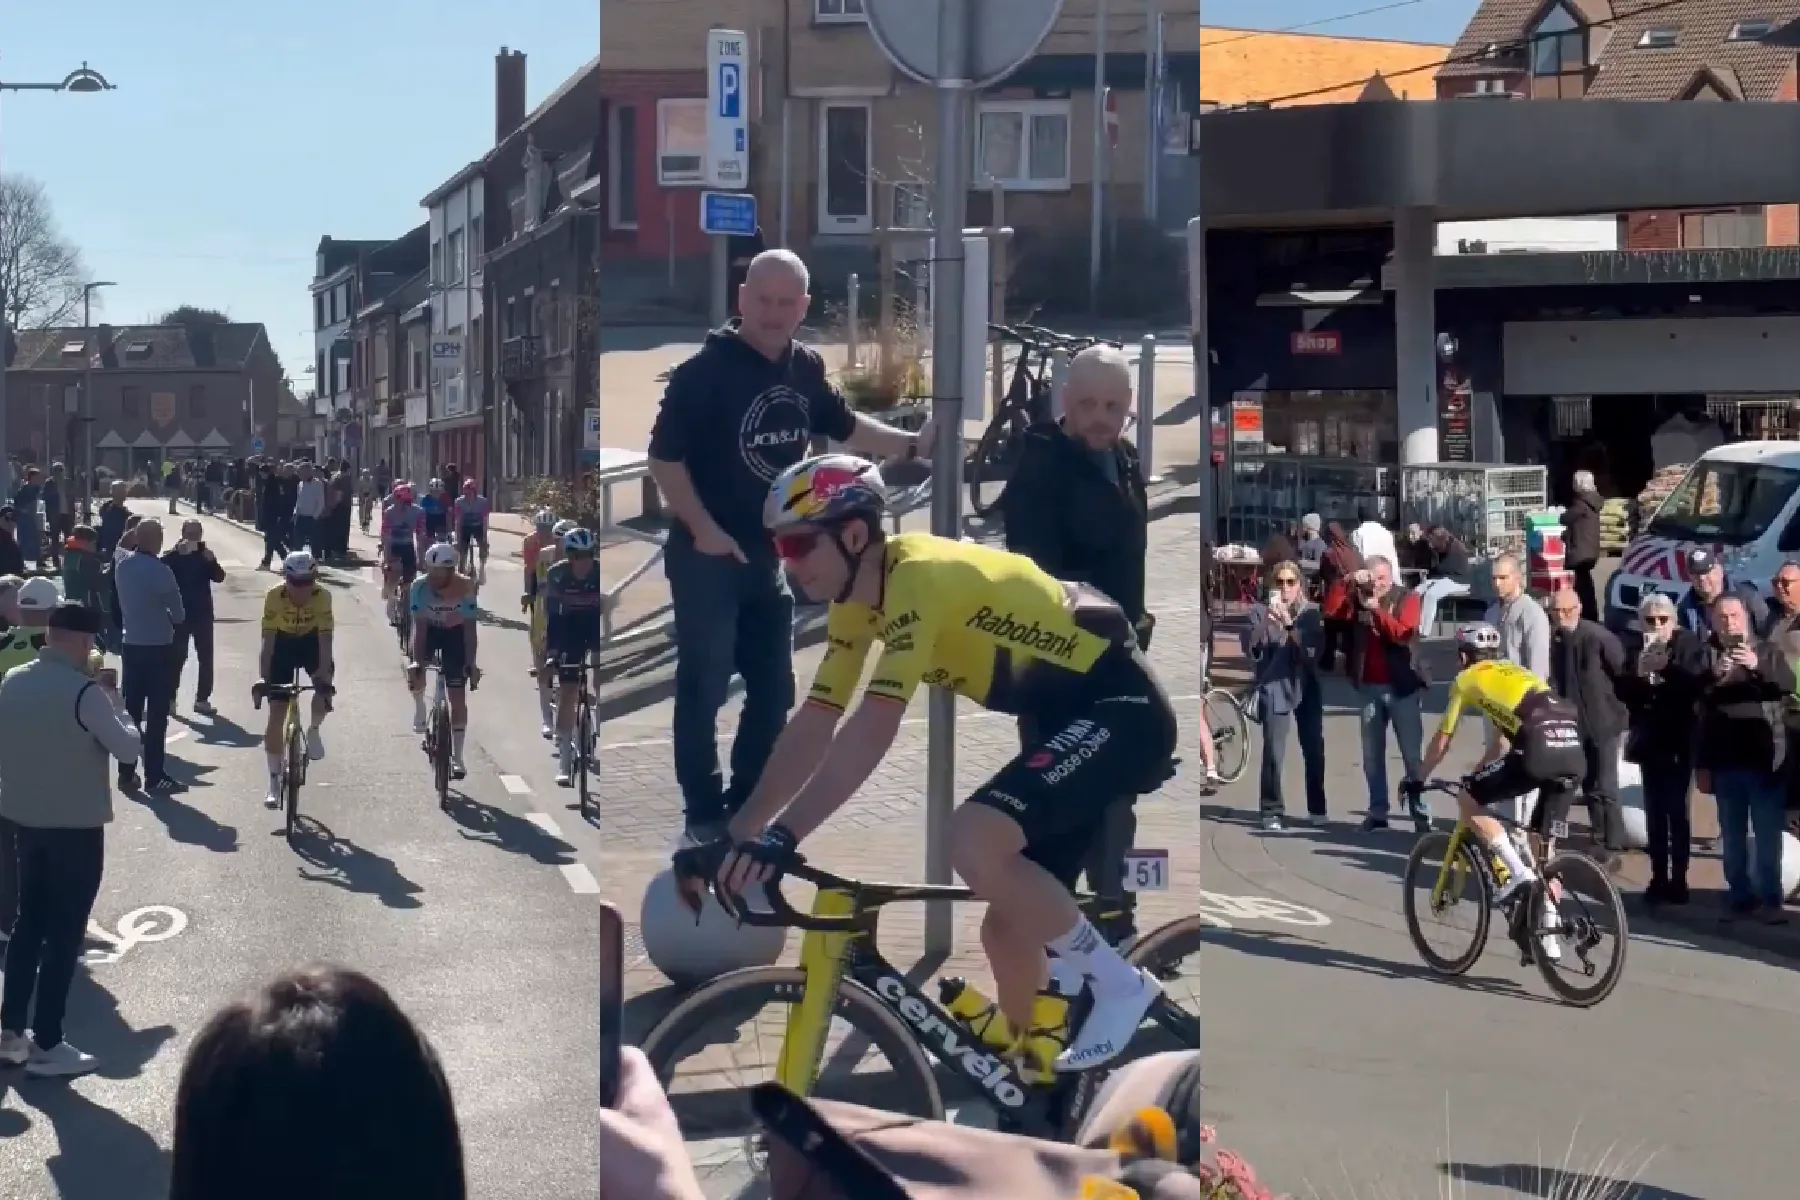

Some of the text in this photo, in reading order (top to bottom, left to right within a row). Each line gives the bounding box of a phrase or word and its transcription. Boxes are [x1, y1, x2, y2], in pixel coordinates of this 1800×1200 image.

[718, 41, 741, 56] ZONE
[722, 66, 737, 115] P
[433, 342, 460, 355] CPH
[1297, 333, 1336, 352] Shop
[965, 605, 1079, 659] Rabobank
[1041, 753, 1082, 785] lease
[1136, 860, 1161, 887] 51
